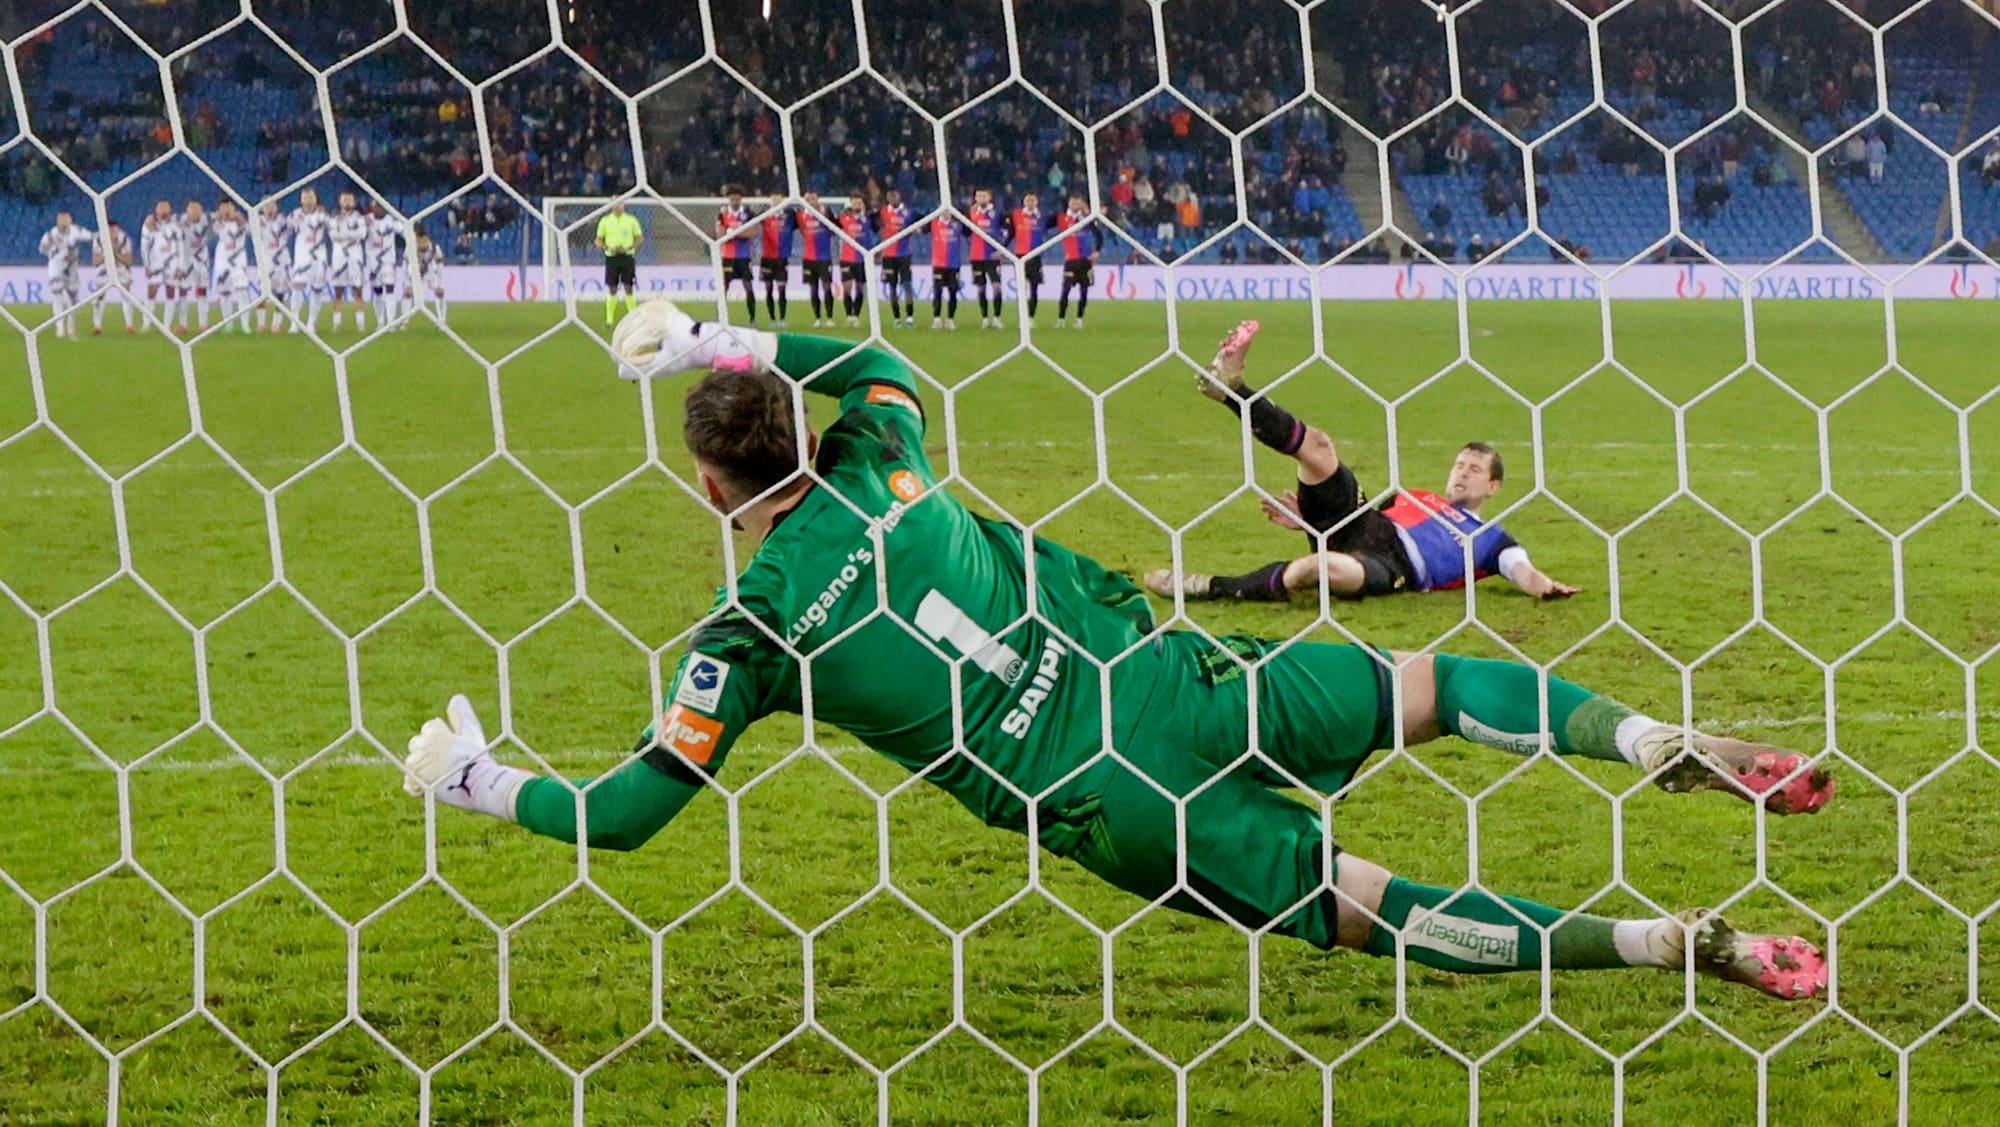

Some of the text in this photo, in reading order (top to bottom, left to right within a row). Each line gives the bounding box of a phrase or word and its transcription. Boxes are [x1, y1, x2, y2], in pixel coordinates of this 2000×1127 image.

[1153, 278, 1313, 301] NOVARTIS
[1441, 277, 1597, 300] NOVARTIS
[914, 588, 1029, 688] 1
